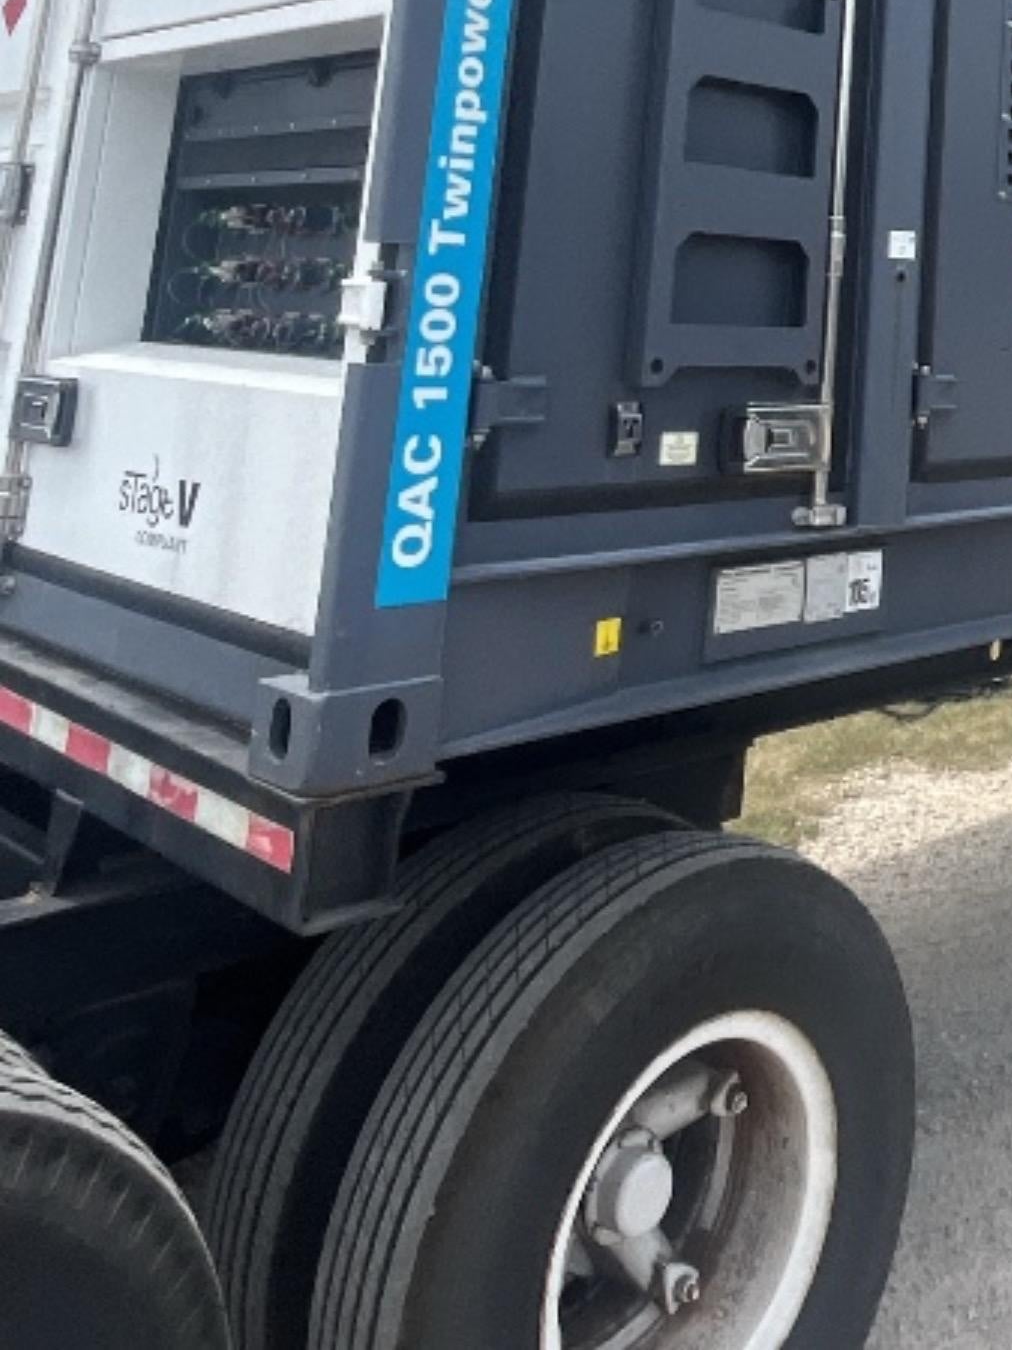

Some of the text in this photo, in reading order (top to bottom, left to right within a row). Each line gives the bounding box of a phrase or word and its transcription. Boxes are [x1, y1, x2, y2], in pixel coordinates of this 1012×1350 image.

[412, 271, 462, 409] 1500
[177, 478, 202, 529] V
[391, 433, 443, 569] QAC
